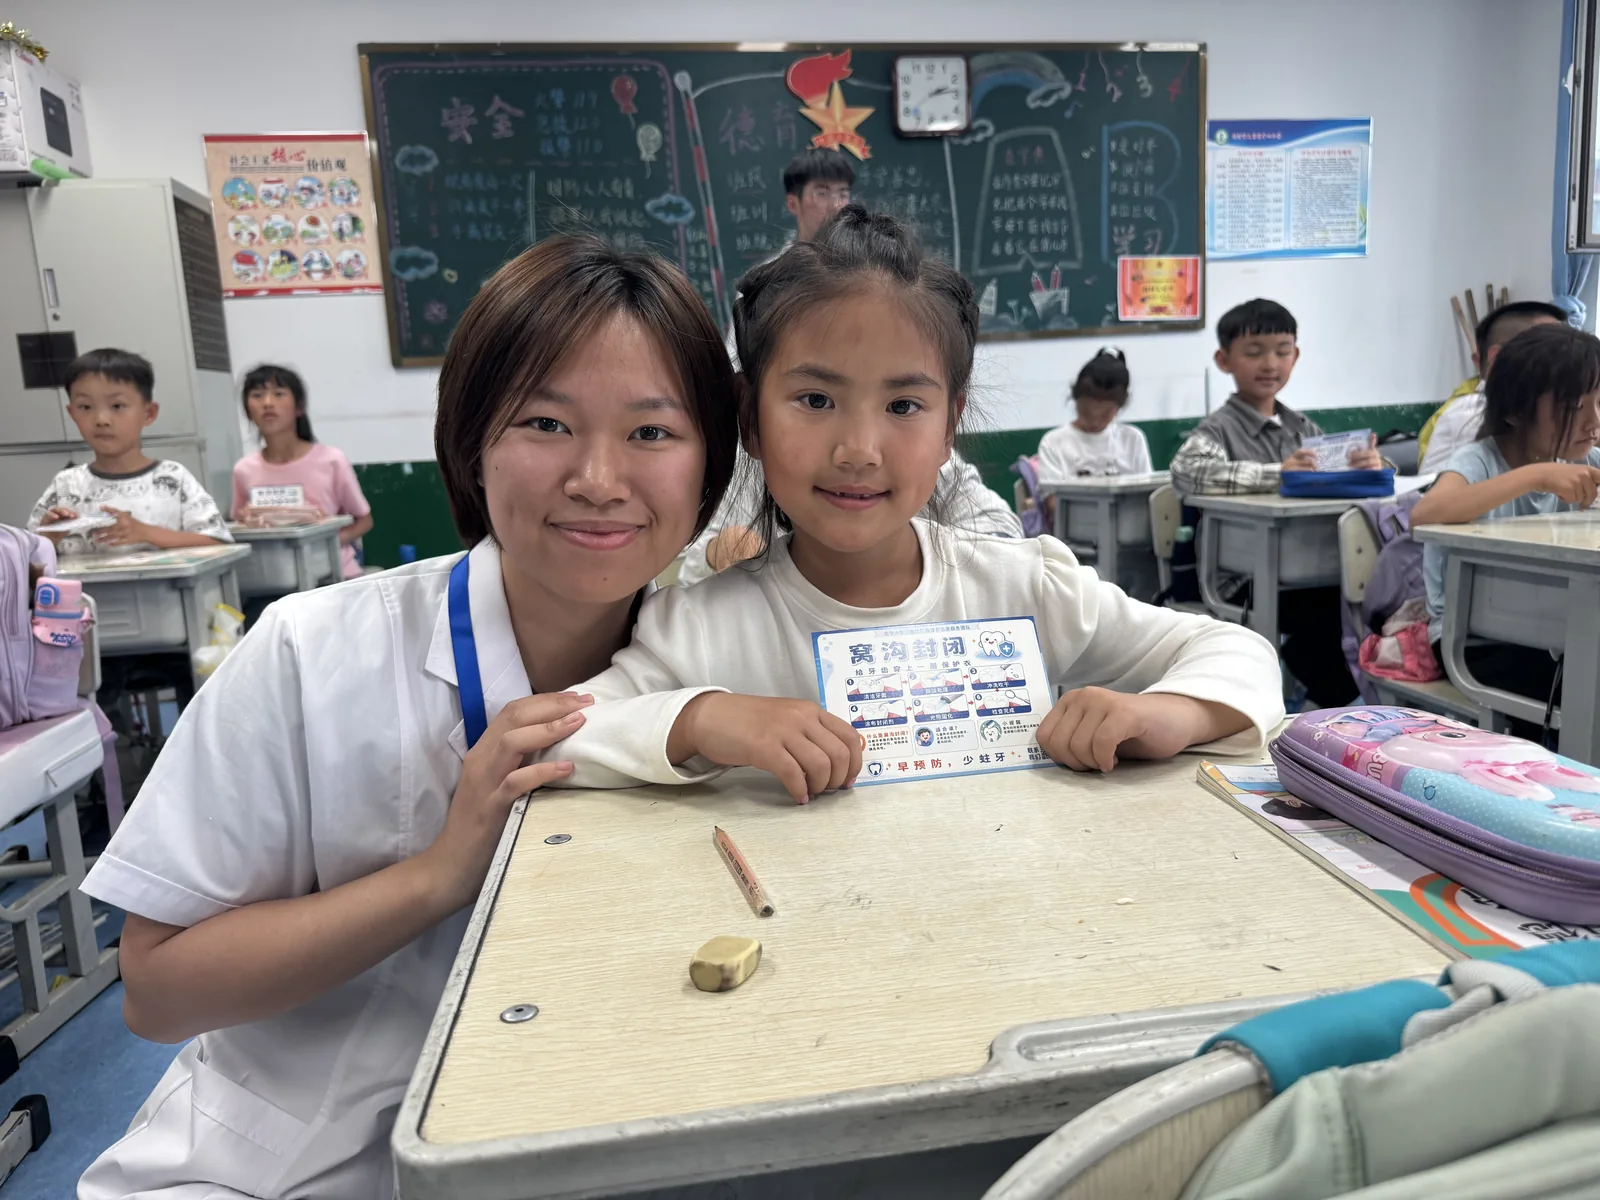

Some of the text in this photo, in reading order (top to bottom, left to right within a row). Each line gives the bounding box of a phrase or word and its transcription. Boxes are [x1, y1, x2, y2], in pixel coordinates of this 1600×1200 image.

[951, 74, 959, 85] 2
[440, 95, 526, 145] 安全
[719, 101, 797, 156] 德育
[849, 636, 967, 665] 窝沟封闭
